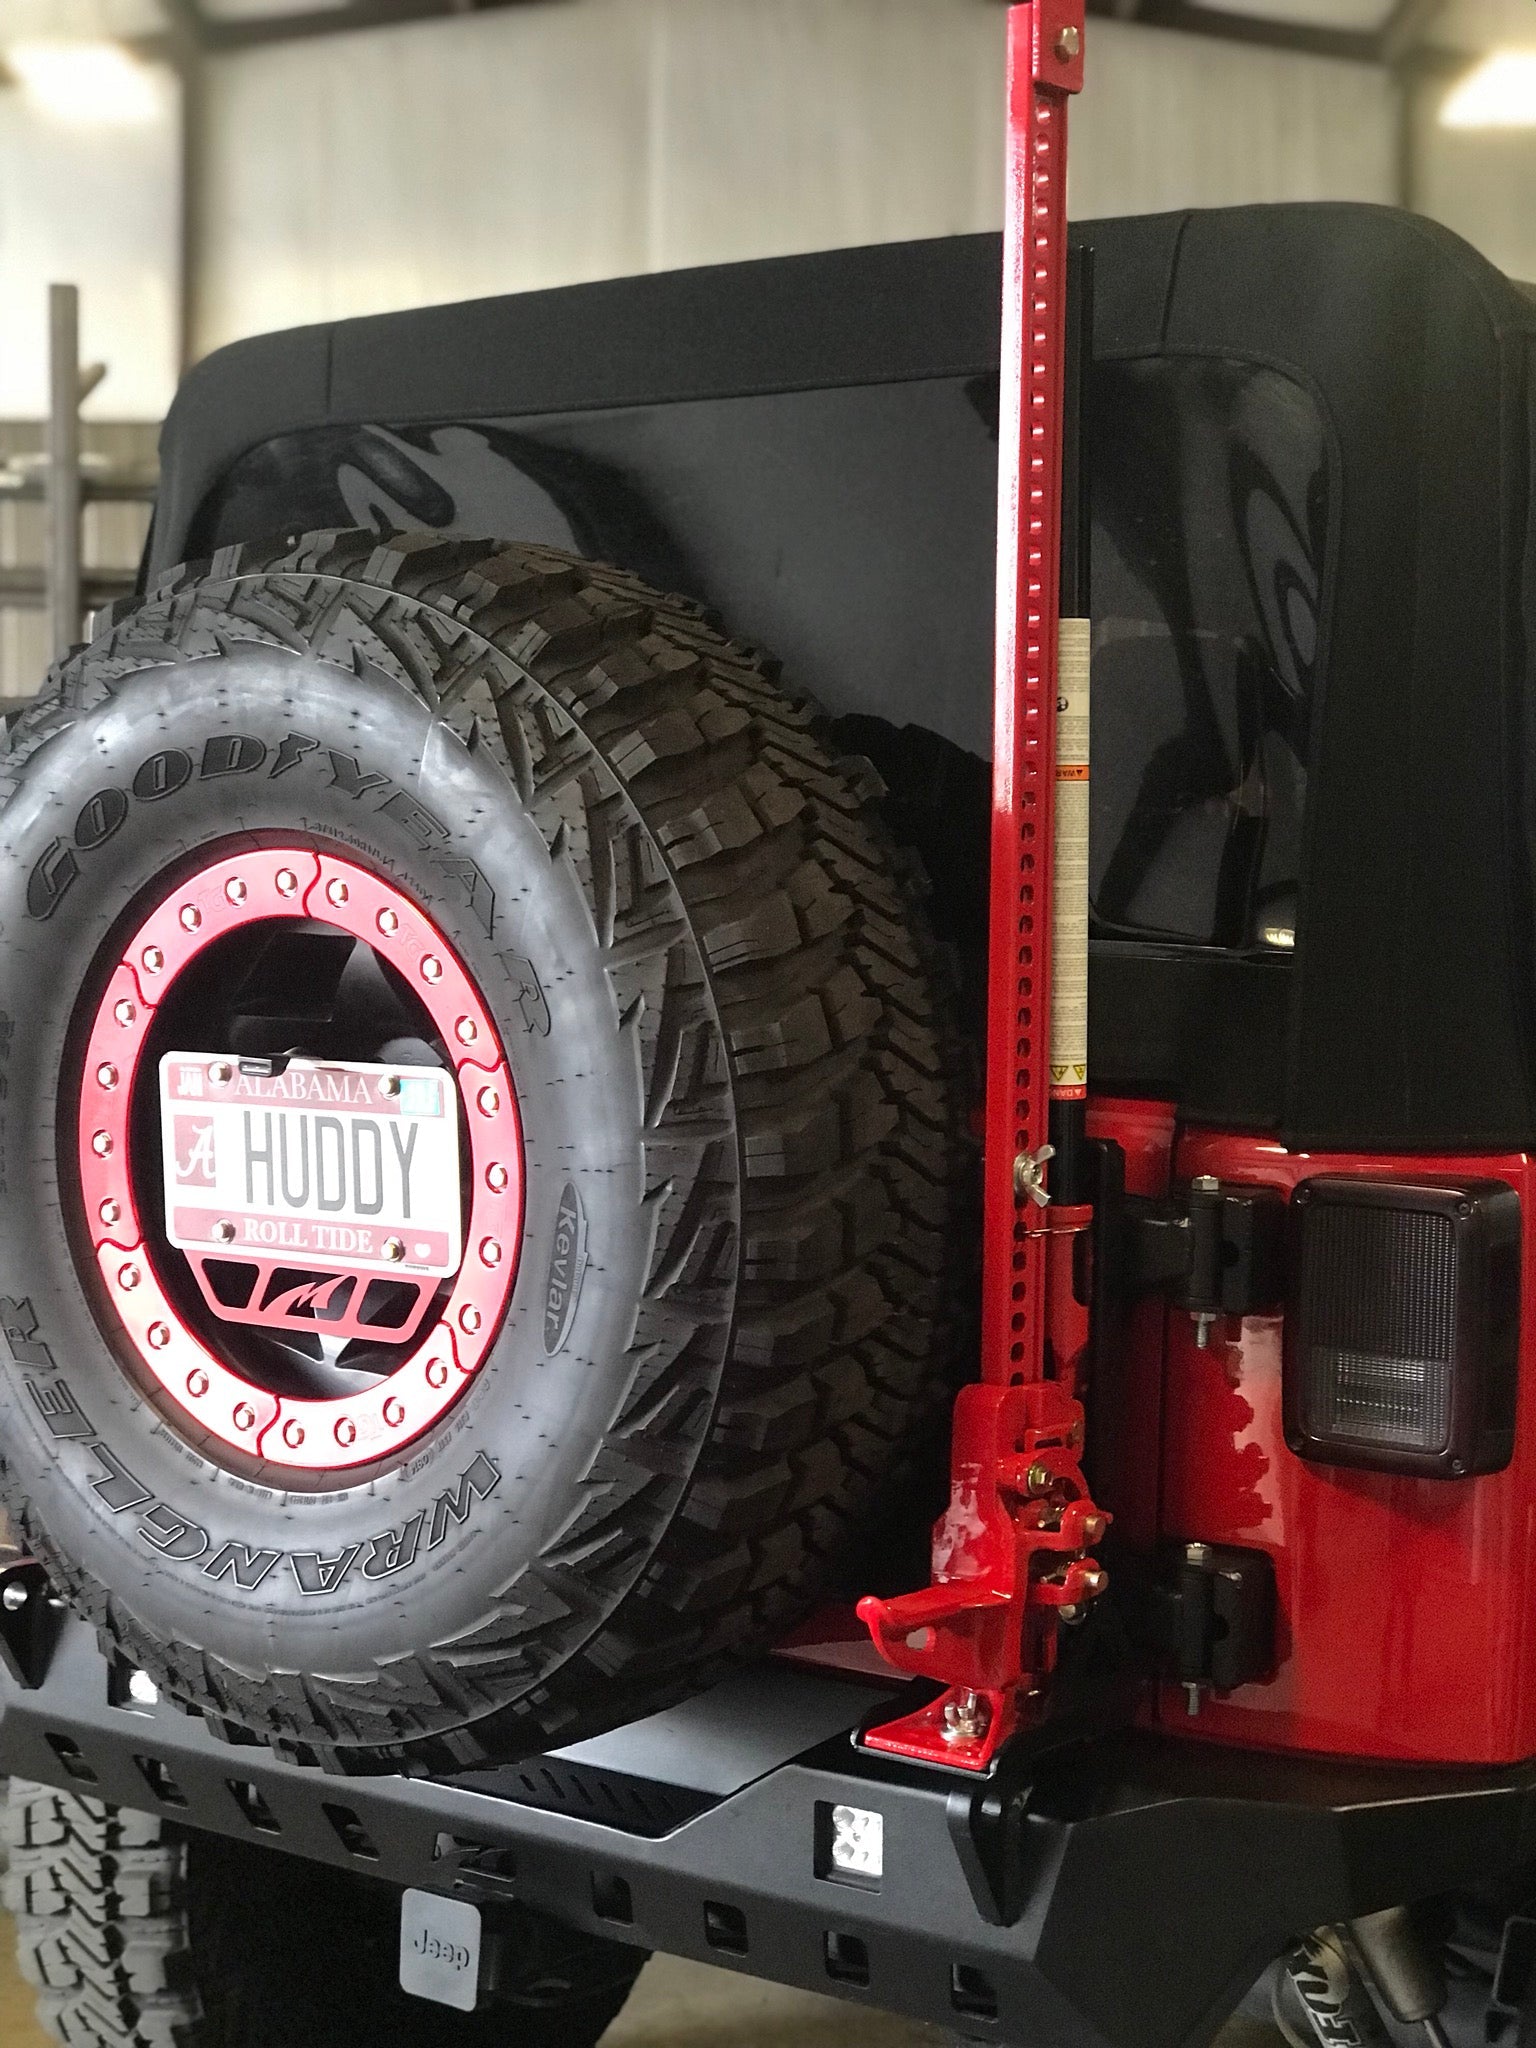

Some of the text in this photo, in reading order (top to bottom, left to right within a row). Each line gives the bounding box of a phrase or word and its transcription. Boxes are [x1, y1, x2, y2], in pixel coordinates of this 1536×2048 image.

[27, 731, 551, 1037] GOODYEAR
[233, 1073, 374, 1105] ALABAMA
[243, 1110, 419, 1219] HUDDY
[242, 1217, 374, 1254] ROLL TIDE
[545, 1206, 578, 1332] Kevlar
[0, 1295, 502, 1597] WRANGLER
[414, 1929, 471, 1971] Jeep
